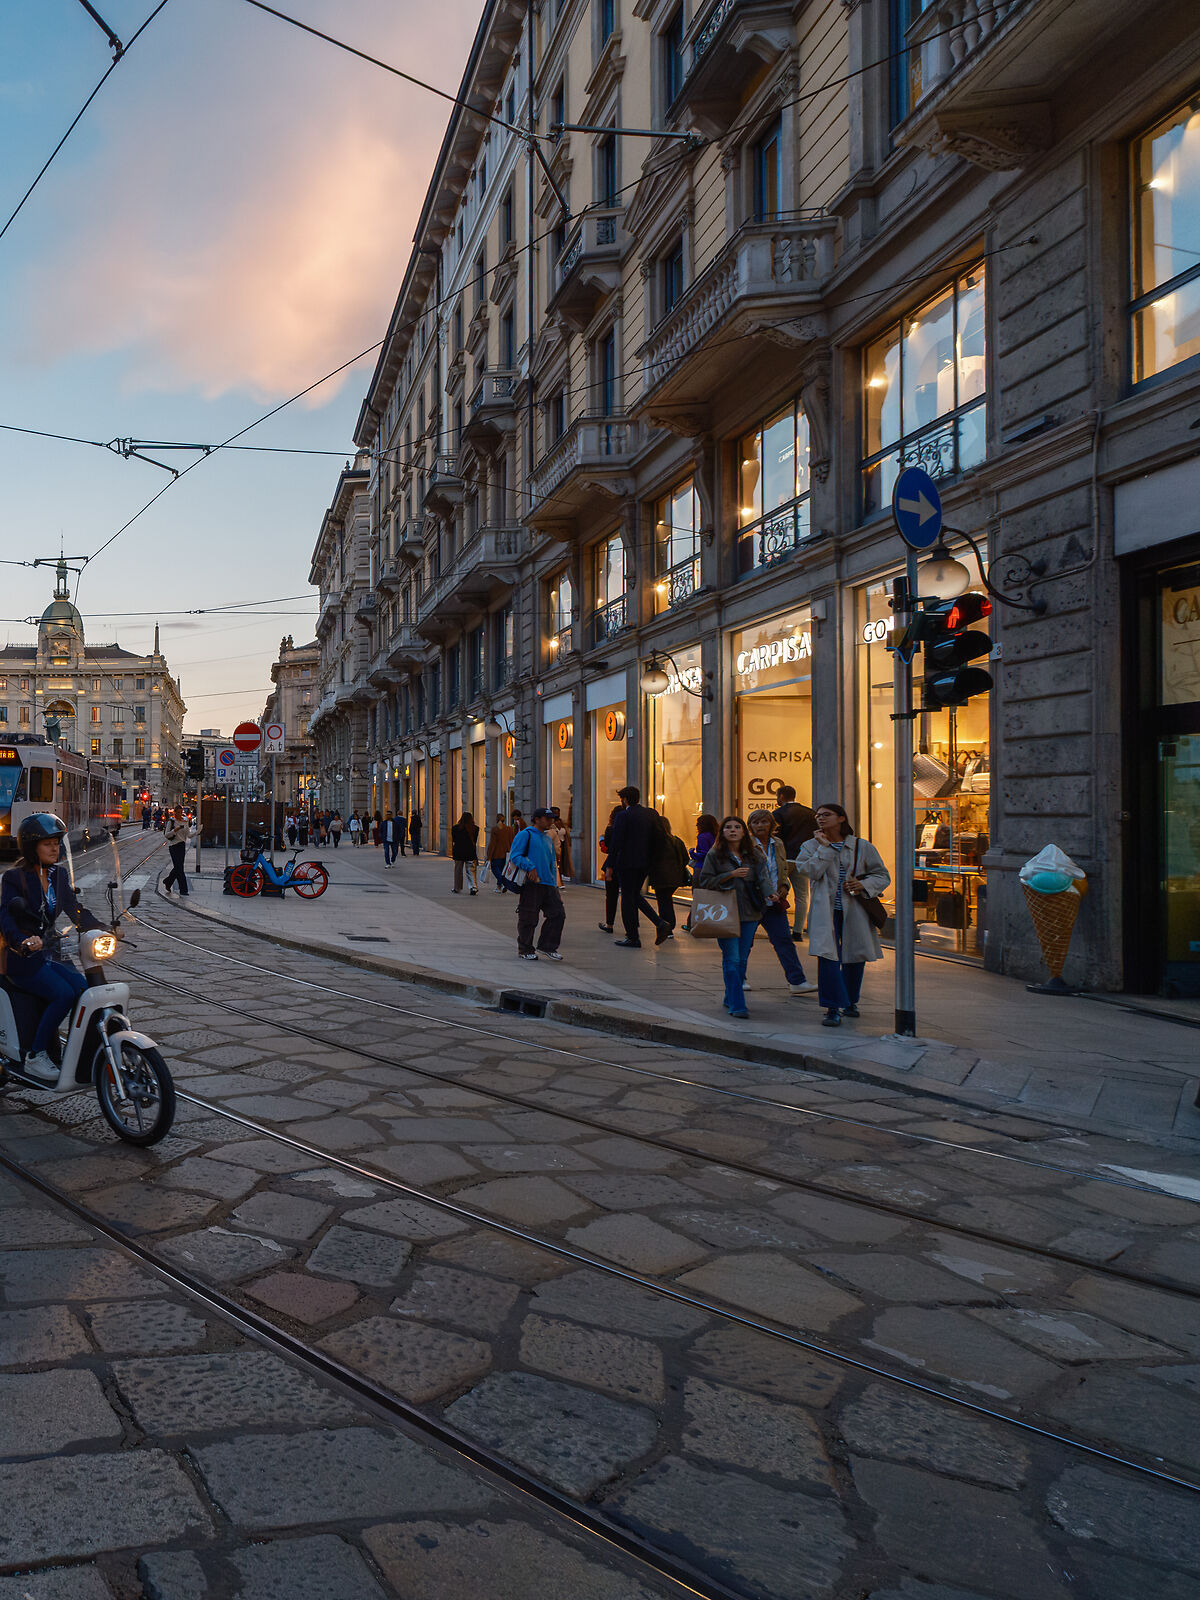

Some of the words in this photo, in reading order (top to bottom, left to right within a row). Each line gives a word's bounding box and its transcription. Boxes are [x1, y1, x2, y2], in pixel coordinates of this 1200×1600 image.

[737, 631, 812, 675] CARPISA
[747, 751, 812, 762] CARPISA
[748, 778, 785, 795] GO
[694, 903, 729, 922] 50
